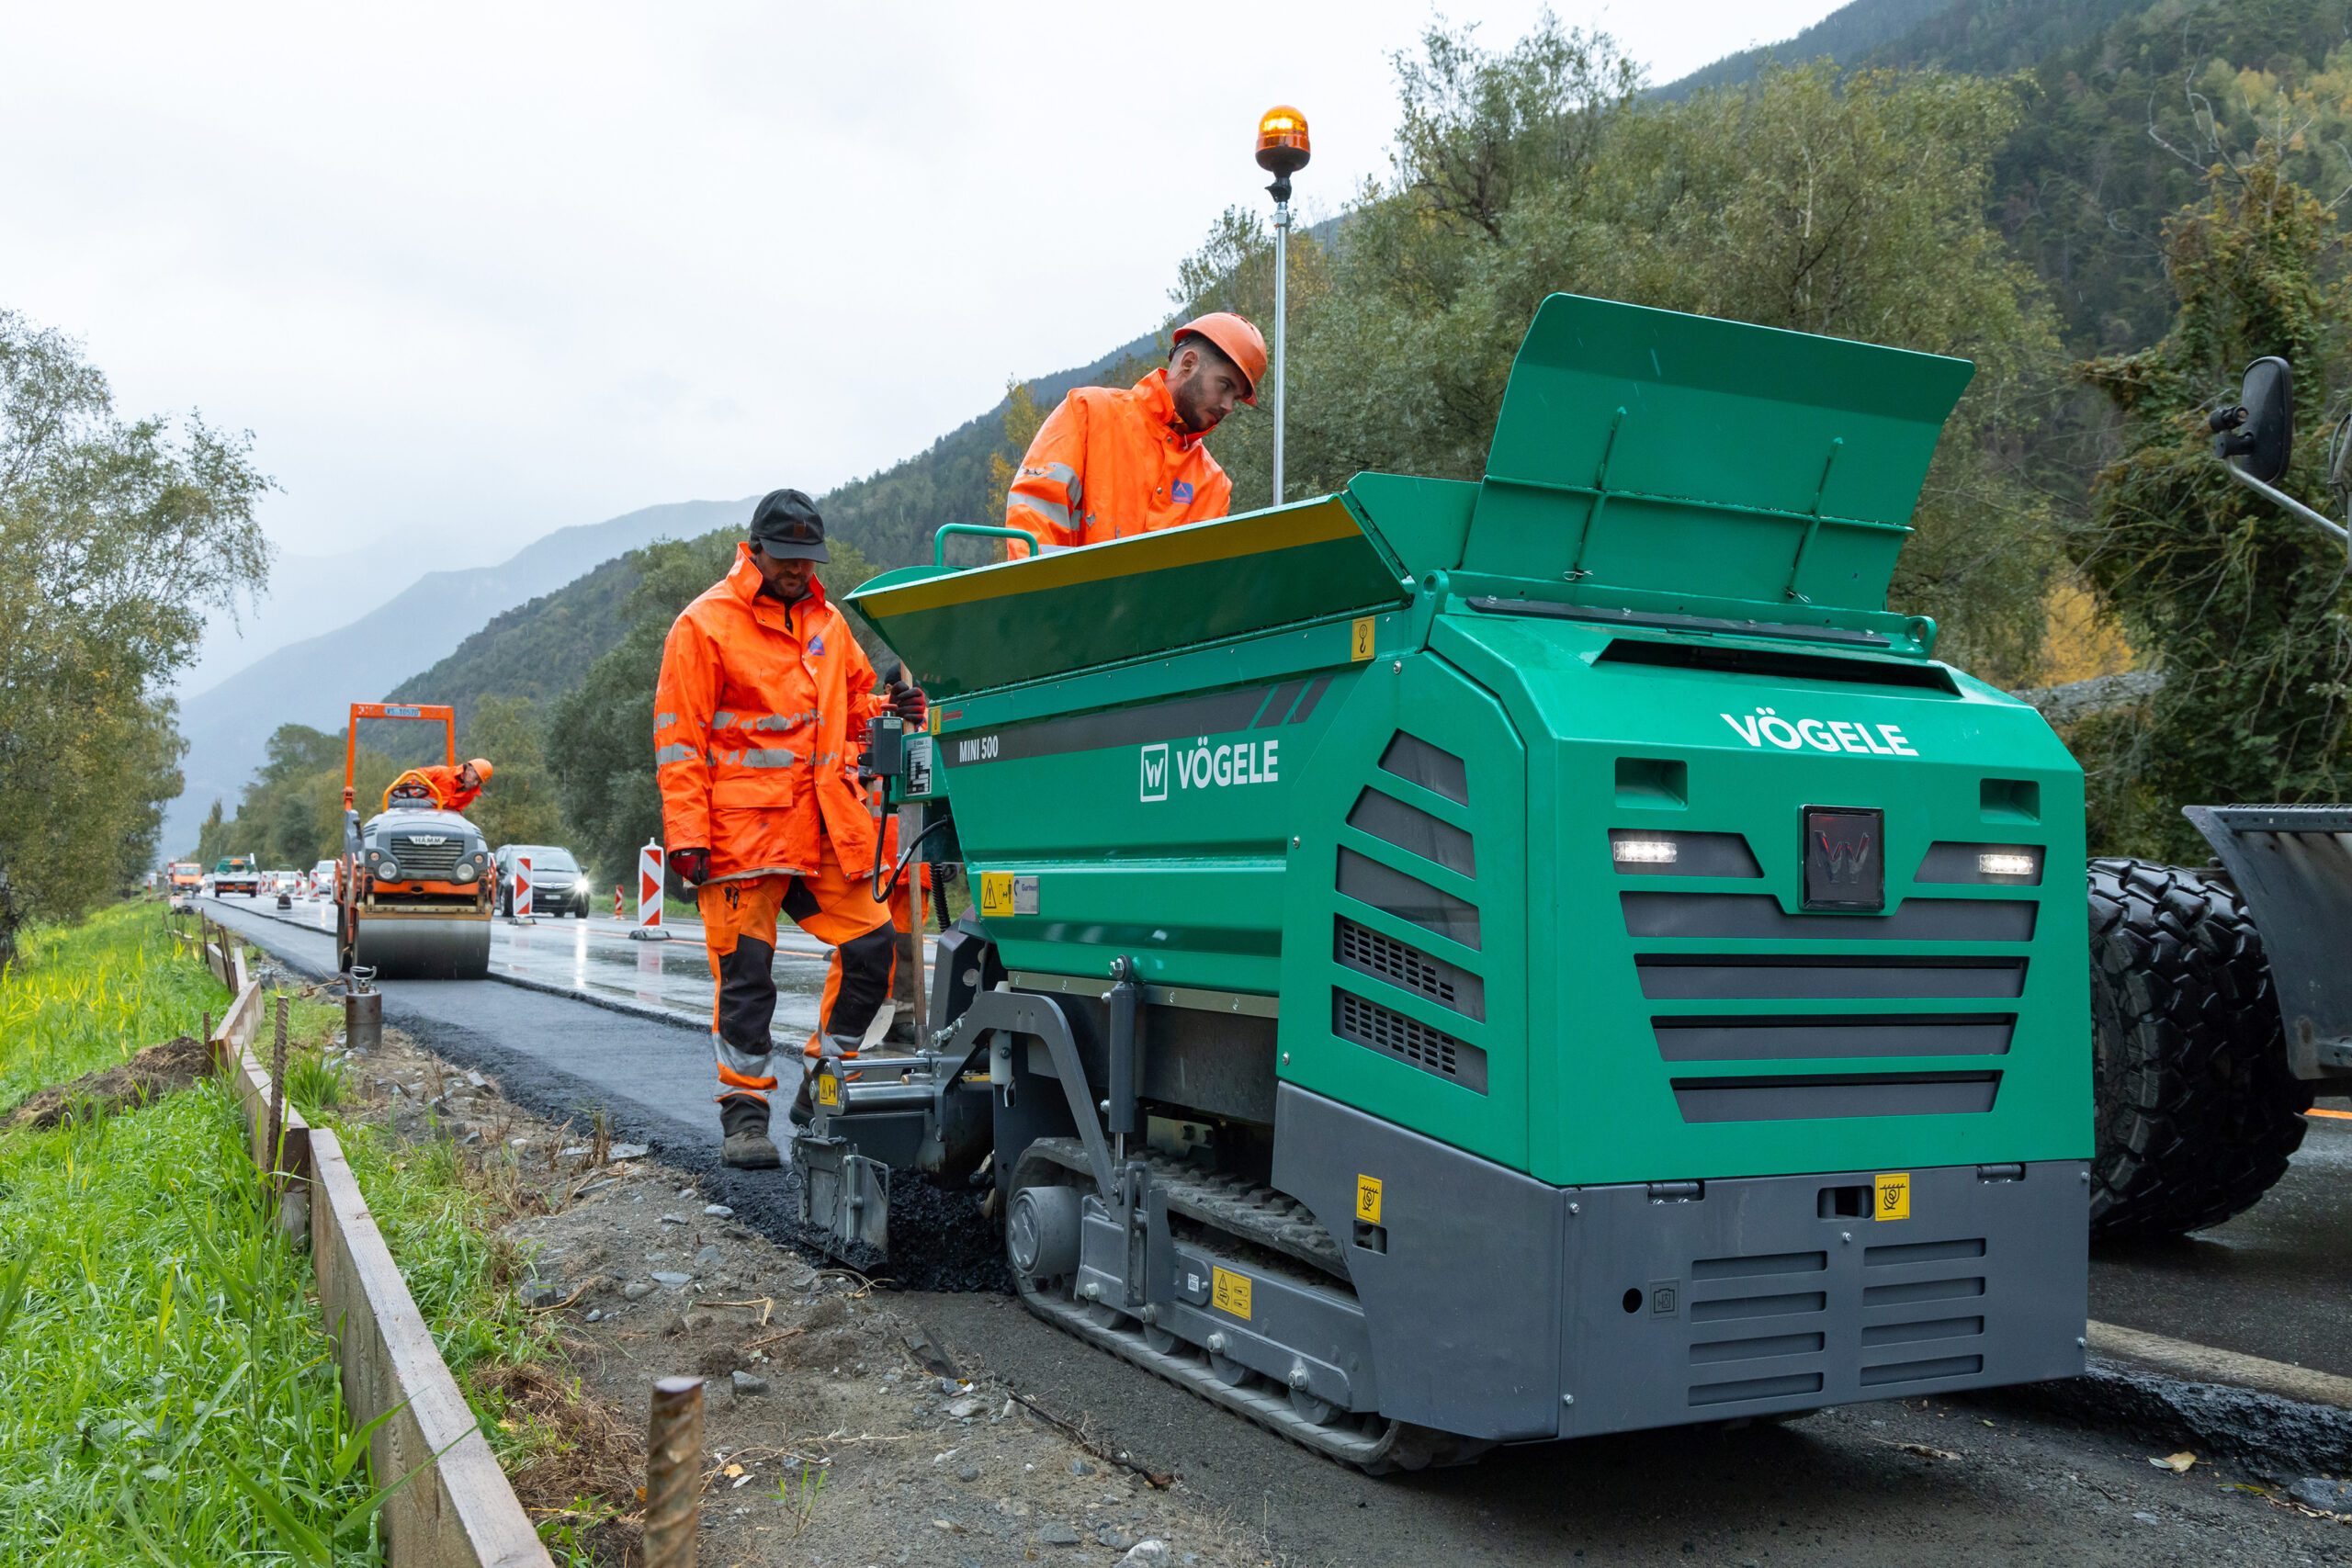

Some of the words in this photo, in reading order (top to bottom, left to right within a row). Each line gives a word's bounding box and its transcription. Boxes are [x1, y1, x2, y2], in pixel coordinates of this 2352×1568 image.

[959, 739, 980, 762] MINI
[981, 735, 999, 759] 500
[1720, 707, 1919, 756] VÖGELE
[1176, 736, 1279, 789] VÖGELE
